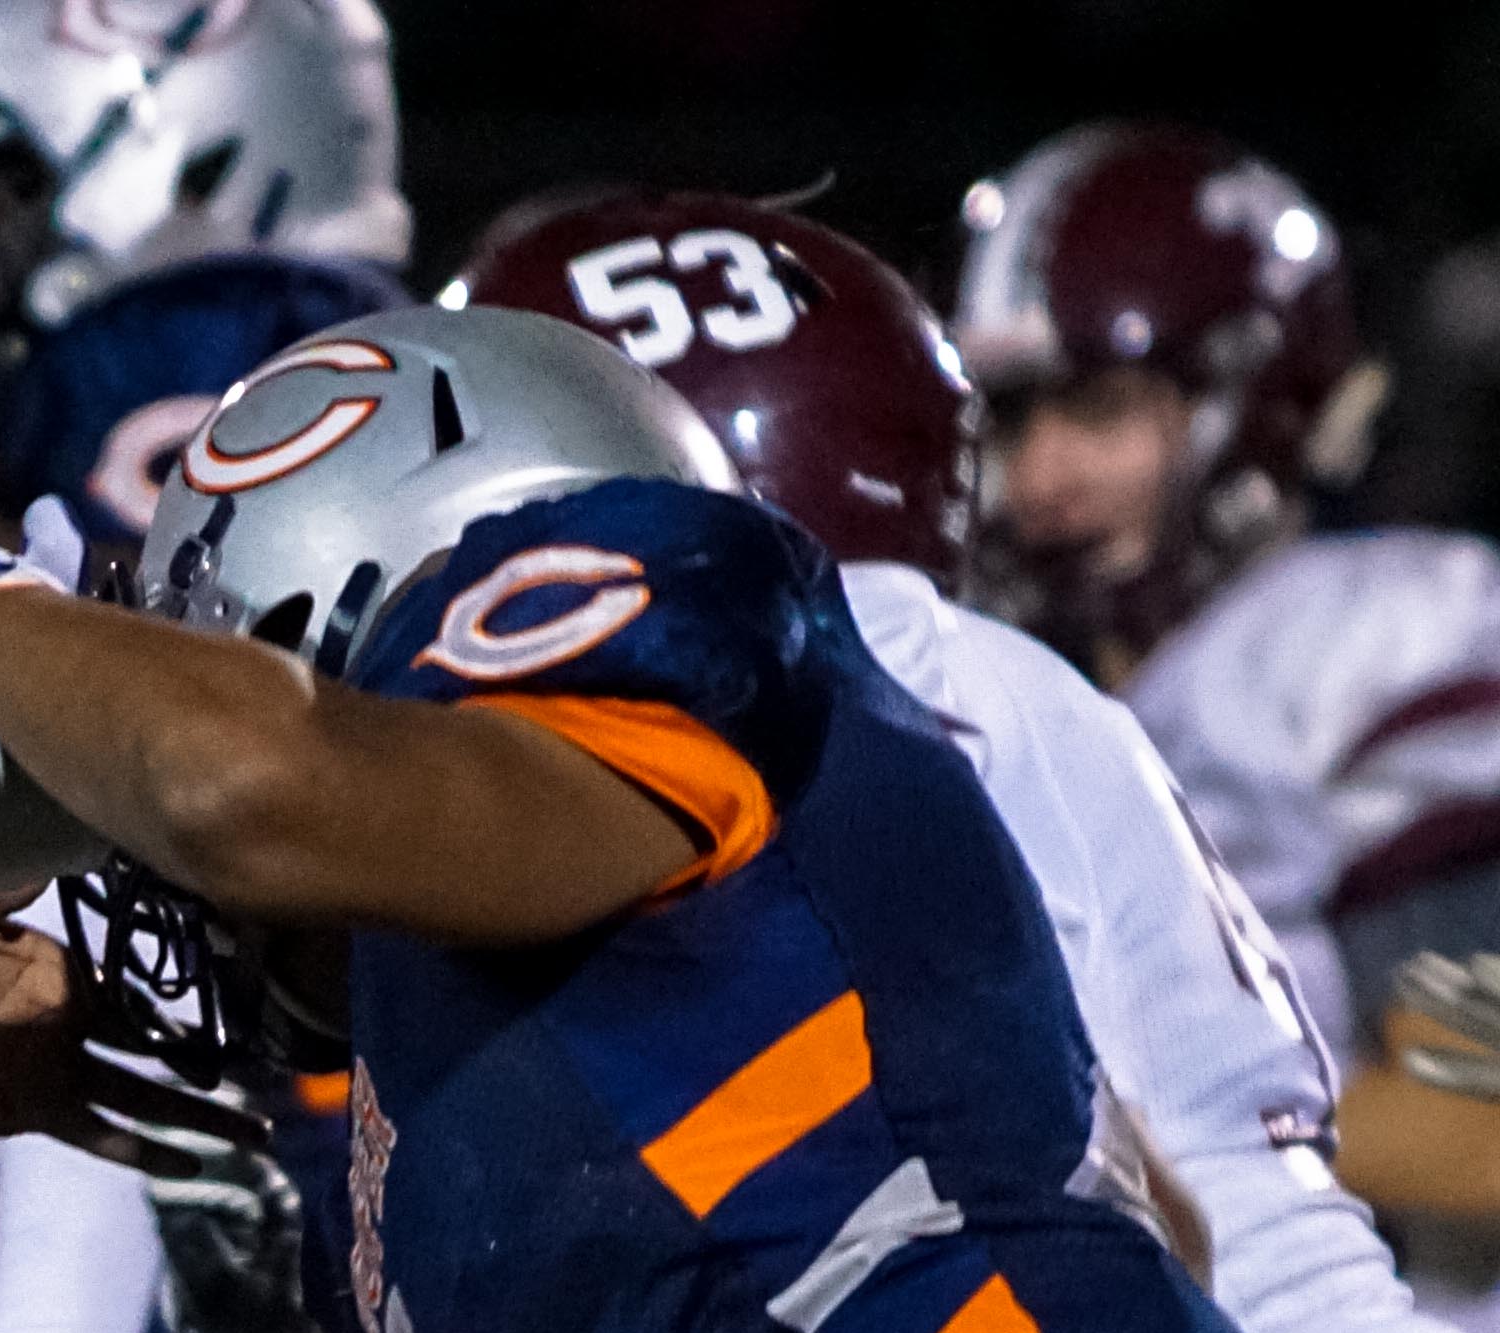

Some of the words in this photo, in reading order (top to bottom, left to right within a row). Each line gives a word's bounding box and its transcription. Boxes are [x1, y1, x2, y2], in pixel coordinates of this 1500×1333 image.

[567, 229, 795, 368] 53
[183, 339, 396, 494] C
[411, 543, 651, 680] C
